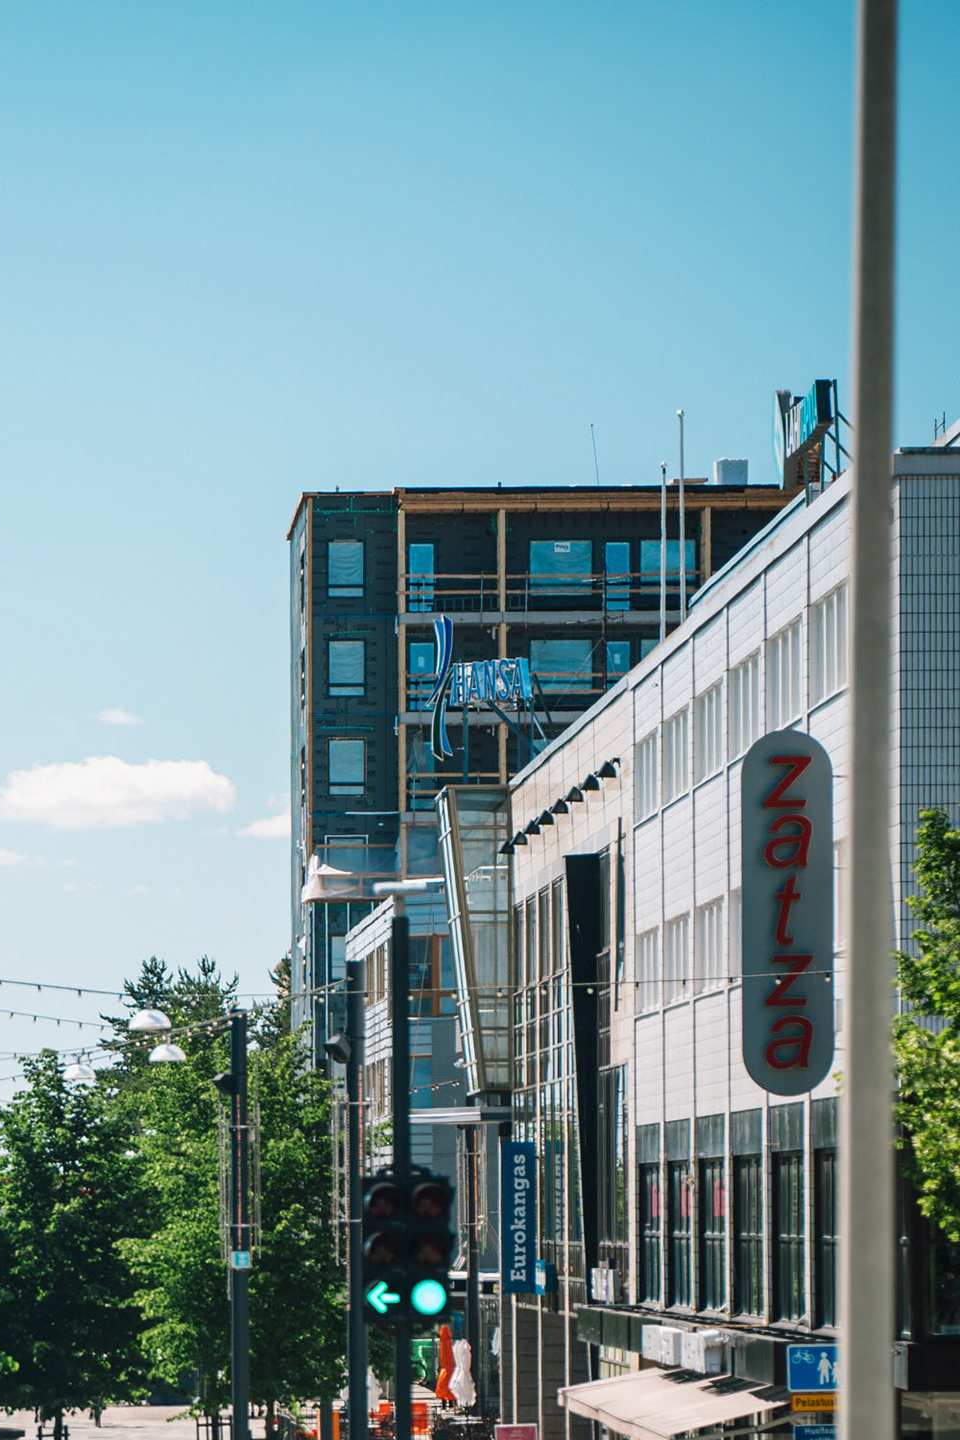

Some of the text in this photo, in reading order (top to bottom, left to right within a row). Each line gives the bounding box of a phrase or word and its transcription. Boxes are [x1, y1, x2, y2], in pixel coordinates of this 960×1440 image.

[452, 657, 525, 703] HANSA
[763, 755, 814, 1070] zatza
[510, 1154, 531, 1282] Eurokangas
